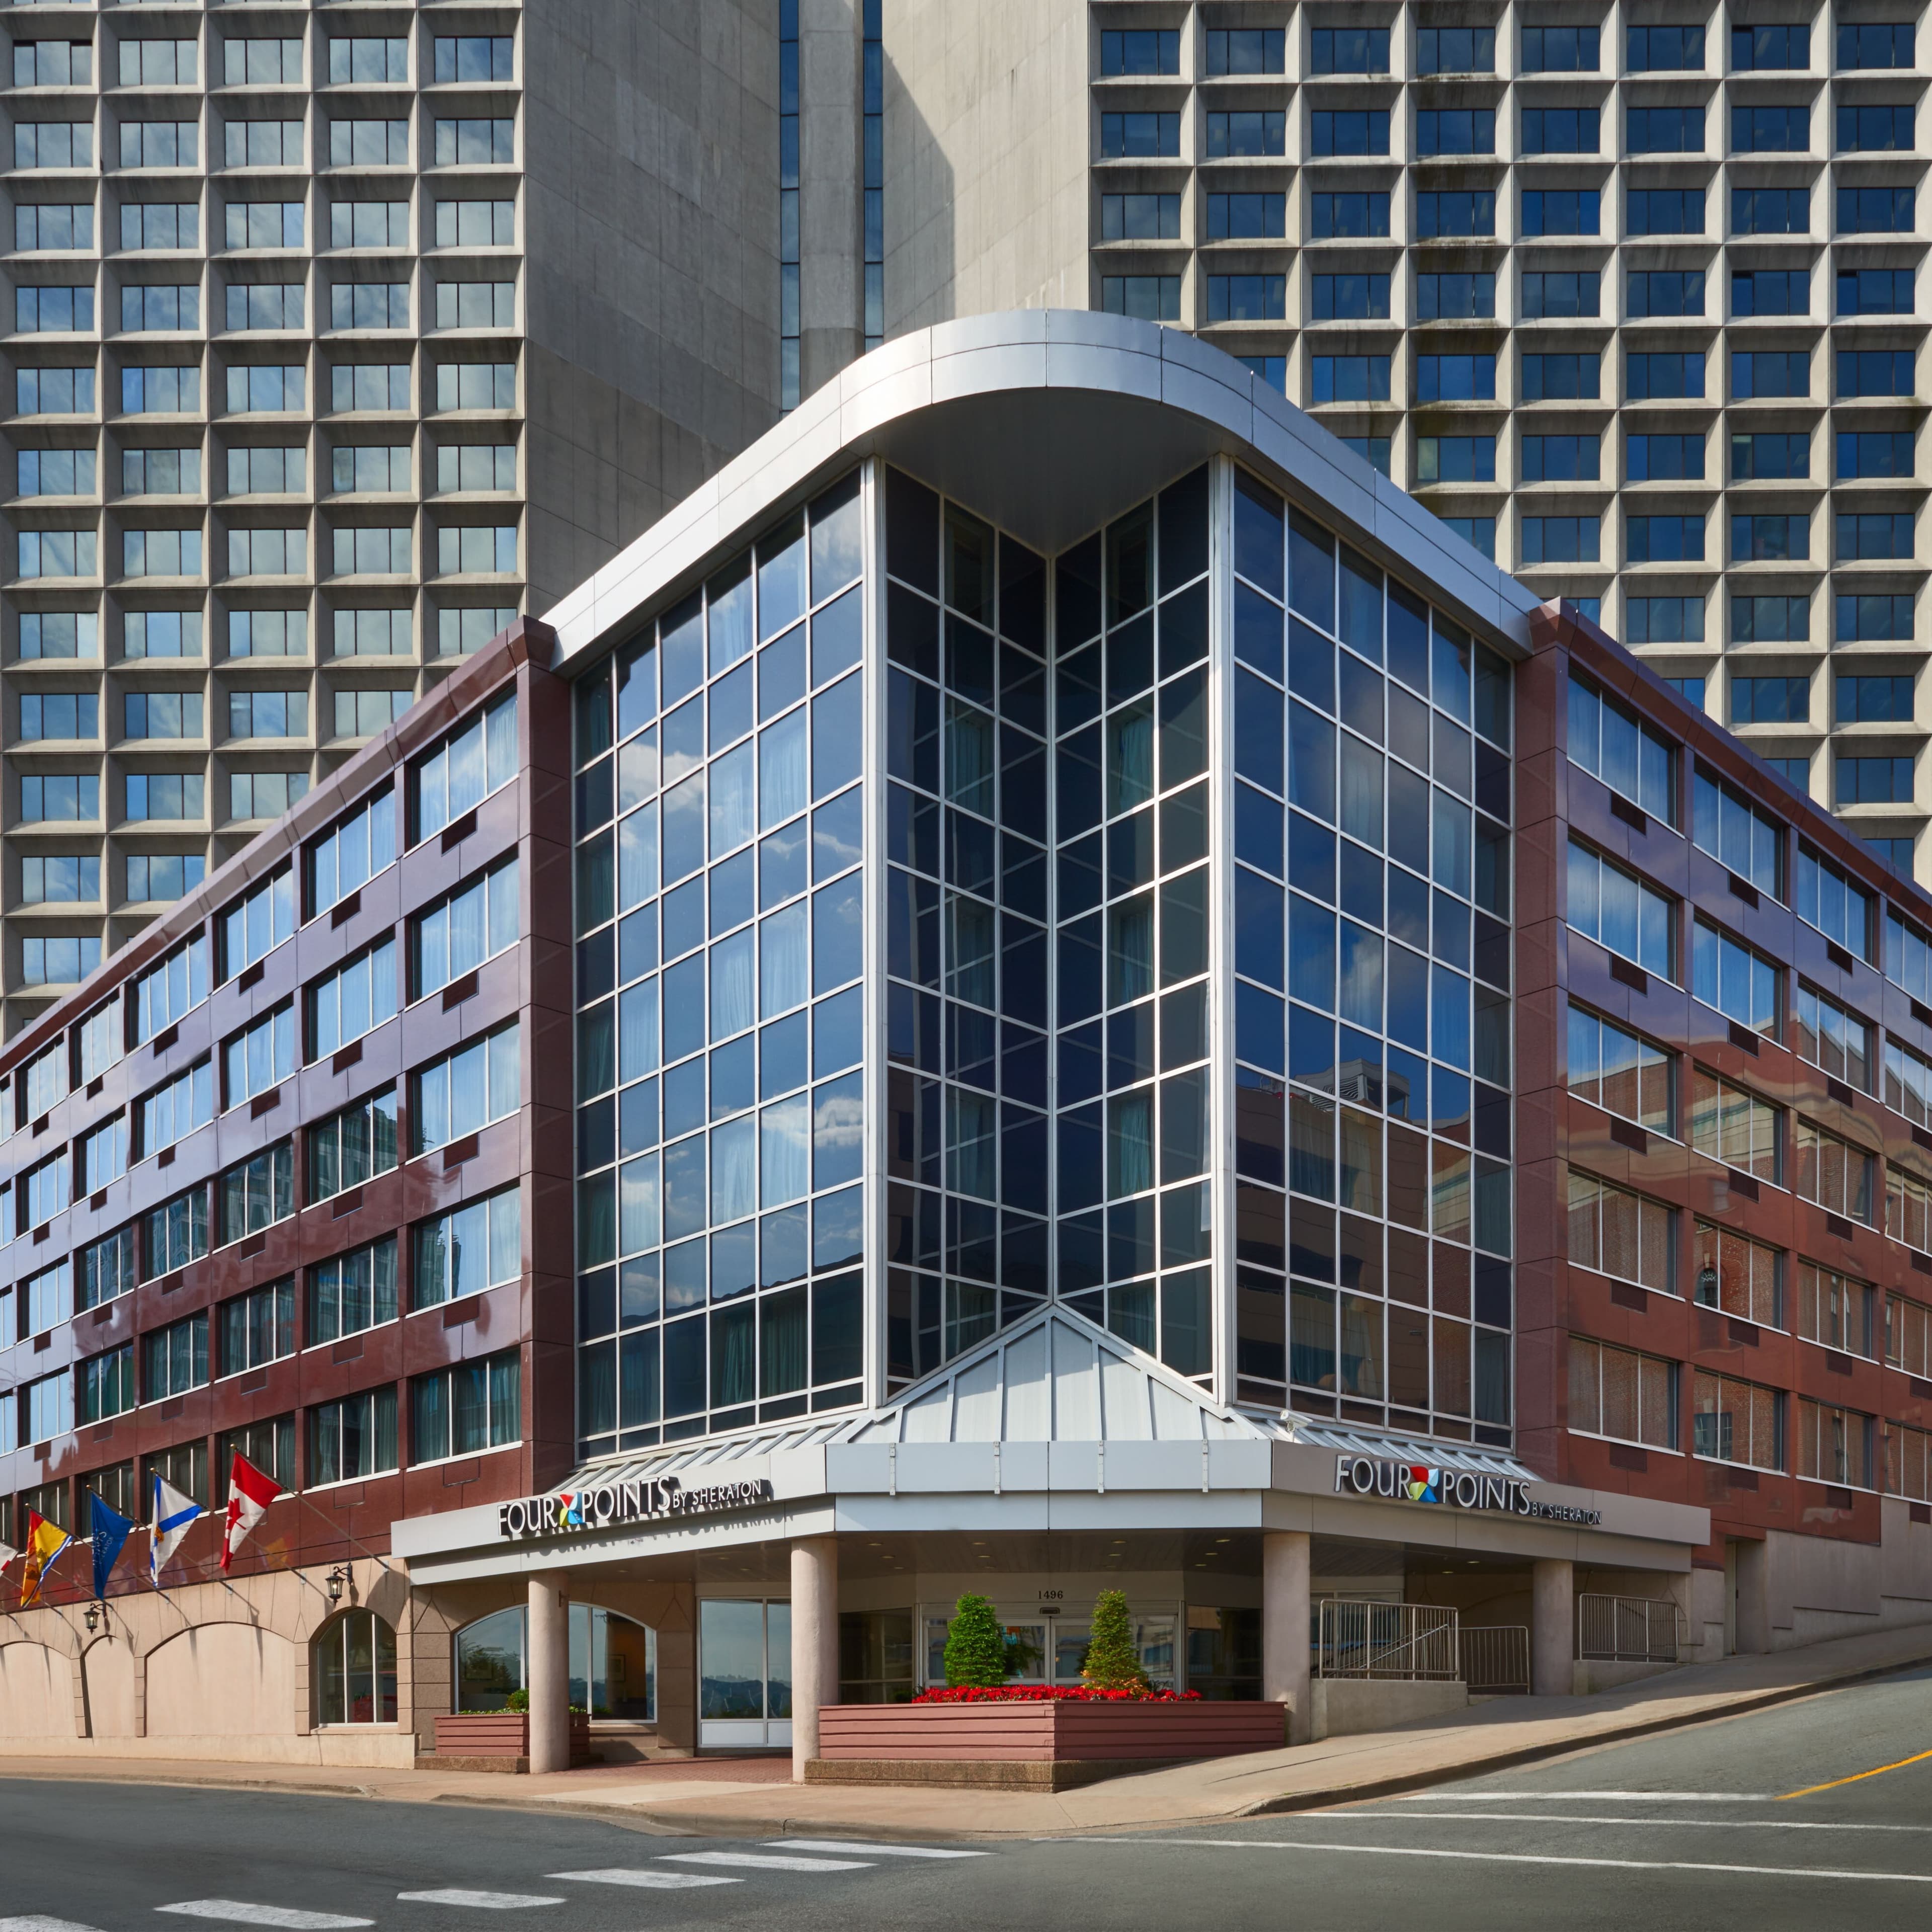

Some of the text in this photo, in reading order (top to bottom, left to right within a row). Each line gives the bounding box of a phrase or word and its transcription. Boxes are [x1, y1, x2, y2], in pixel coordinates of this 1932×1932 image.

[497, 1475, 762, 1535] FOUR POINTS BY SHERATON
[1335, 1454, 1601, 1524] FOUR POINTS BY SHERATON
[1038, 1590, 1063, 1599] 1496
